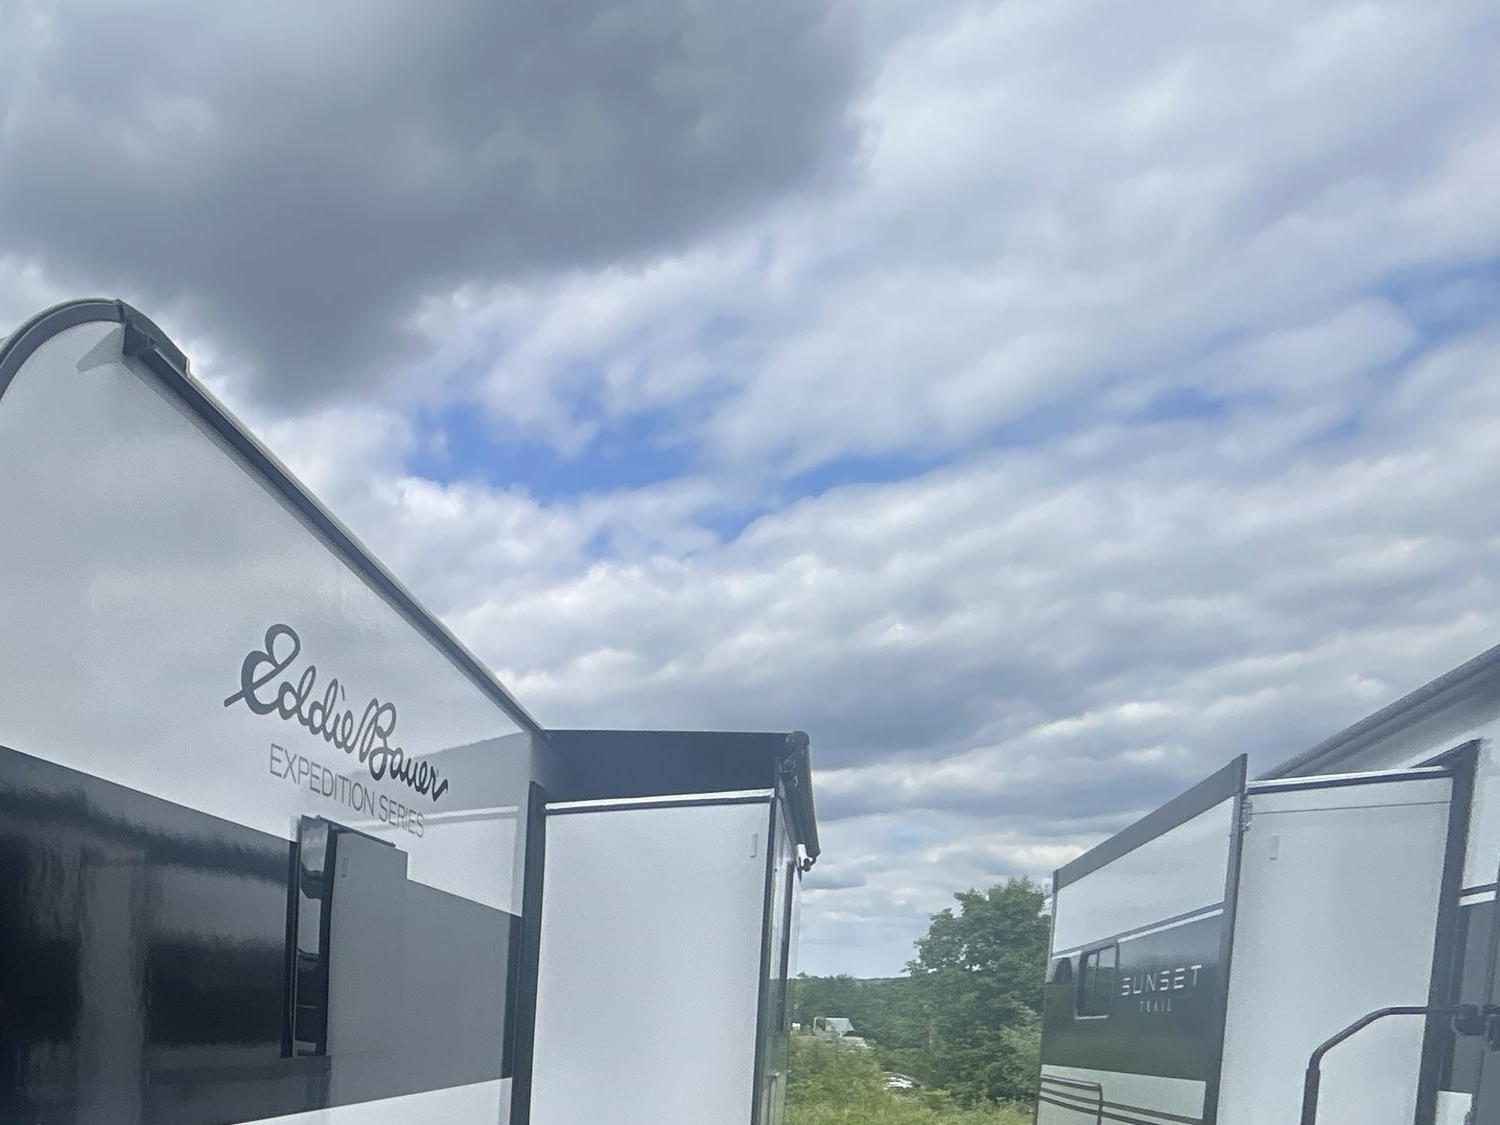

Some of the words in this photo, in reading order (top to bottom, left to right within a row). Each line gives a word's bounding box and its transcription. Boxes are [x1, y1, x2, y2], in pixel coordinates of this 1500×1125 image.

[224, 623, 358, 753] Eddie
[358, 698, 448, 801] Bauer
[269, 743, 375, 817] EXPEDITION
[380, 795, 425, 838] SERIES
[1121, 964, 1202, 996] SUNSET
